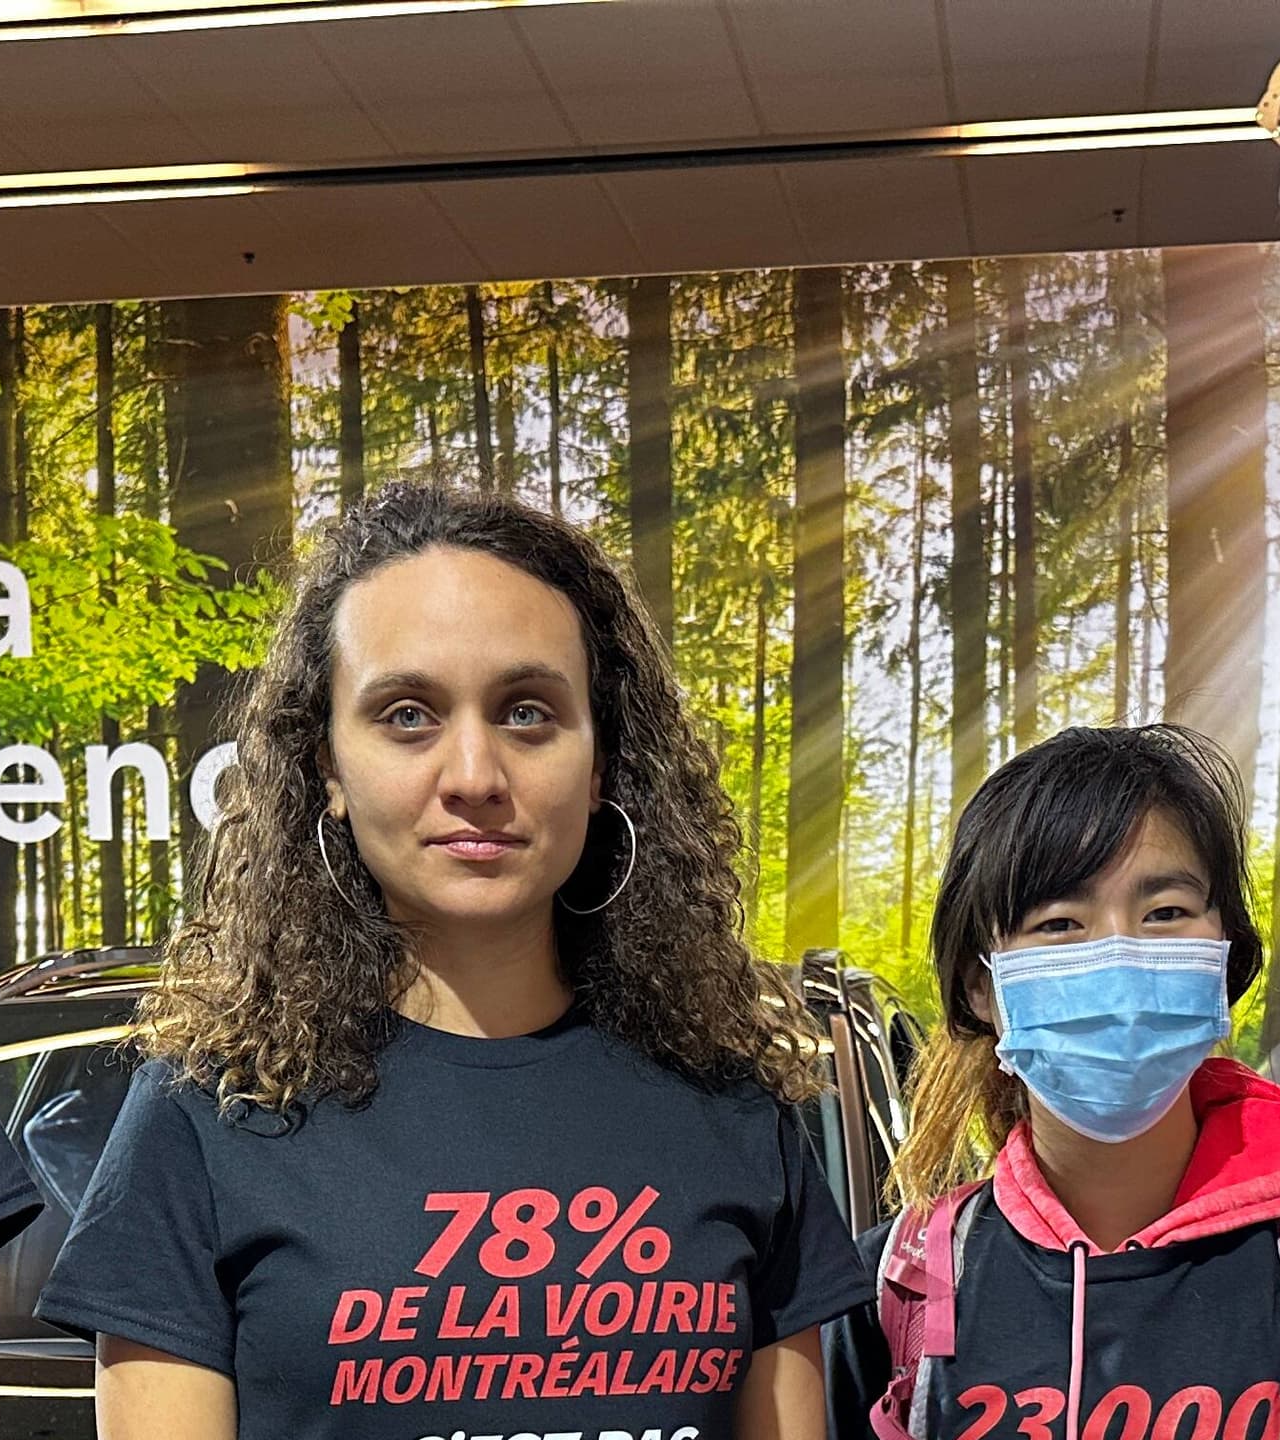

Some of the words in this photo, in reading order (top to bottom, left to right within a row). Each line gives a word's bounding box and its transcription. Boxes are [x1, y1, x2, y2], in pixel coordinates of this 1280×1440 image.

[414, 1184, 672, 1280] 78%
[327, 1286, 428, 1346] DE
[437, 1285, 520, 1340] LA
[545, 1280, 738, 1338] VOIRIE
[329, 1336, 744, 1407] MONTRÉALAISE
